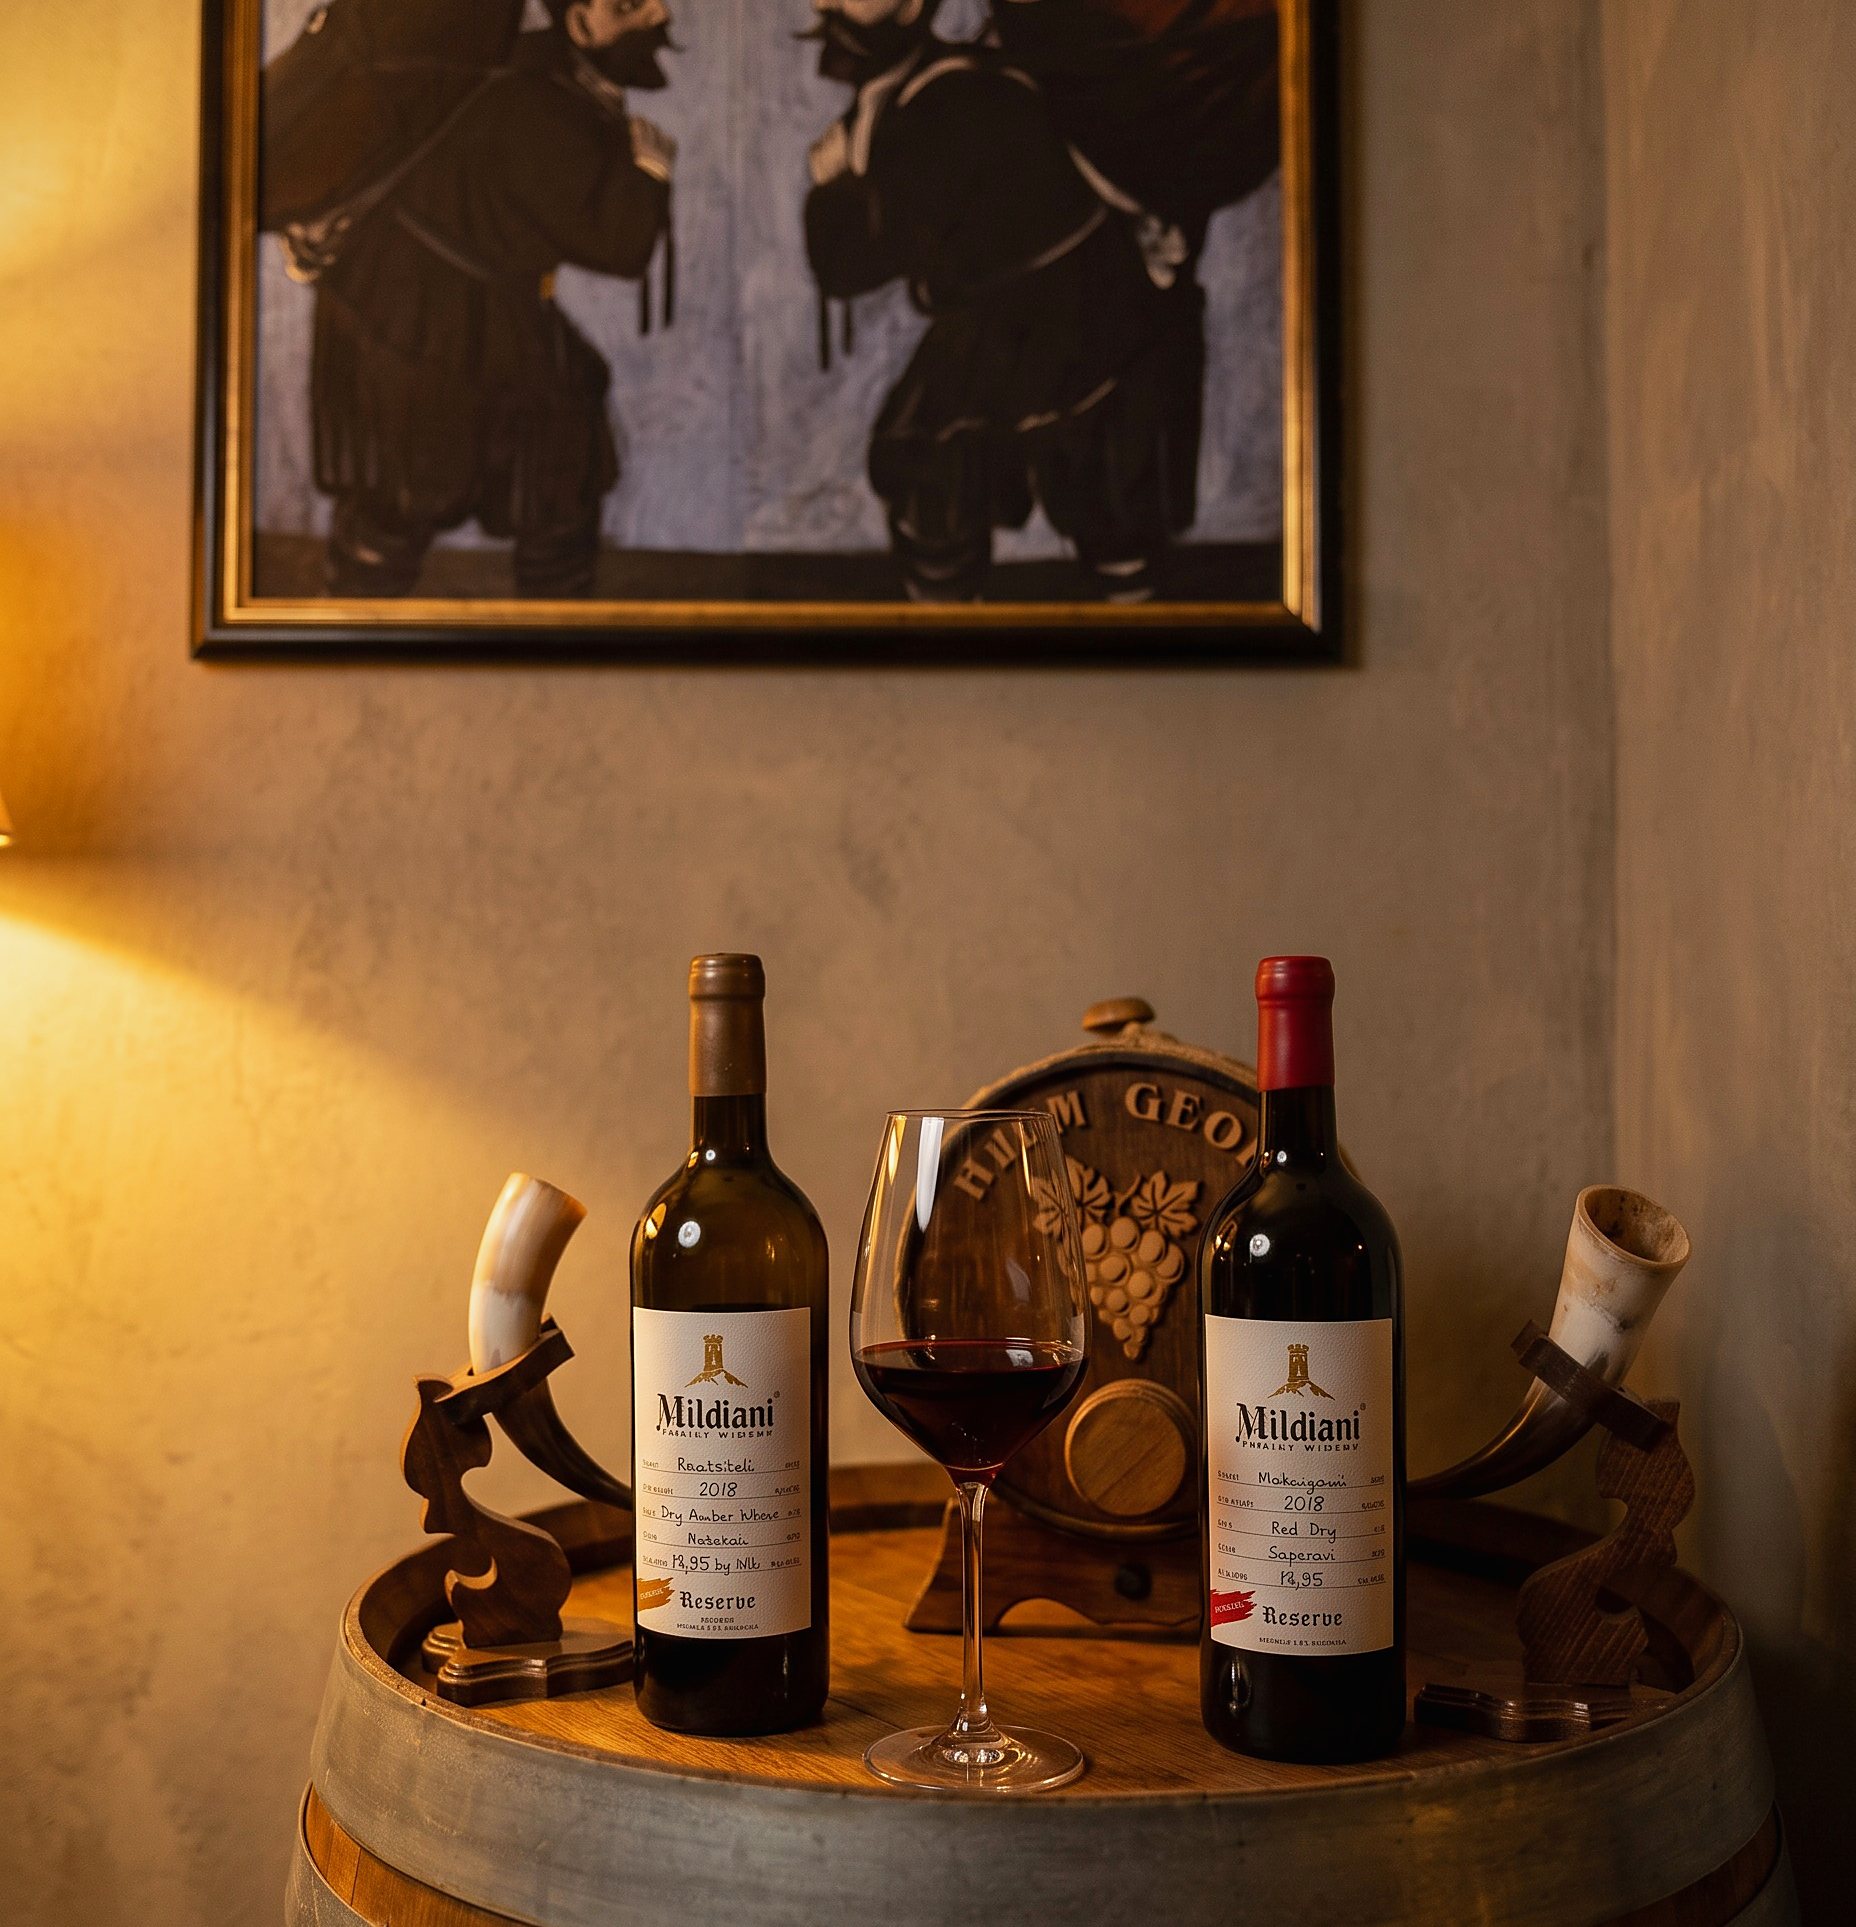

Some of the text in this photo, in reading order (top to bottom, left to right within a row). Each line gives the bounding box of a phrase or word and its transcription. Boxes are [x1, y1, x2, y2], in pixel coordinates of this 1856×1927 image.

[656, 1393, 774, 1431] Mildiani
[1235, 1402, 1360, 1442] Mildiani
[699, 1481, 738, 1497] 2018
[1284, 1495, 1325, 1511] 2018
[661, 1505, 683, 1527] Dry
[1271, 1521, 1337, 1544] Red Dry
[1268, 1545, 1336, 1567] Saperavi
[679, 1591, 756, 1609] Reserve
[1262, 1605, 1343, 1626] Reserve
